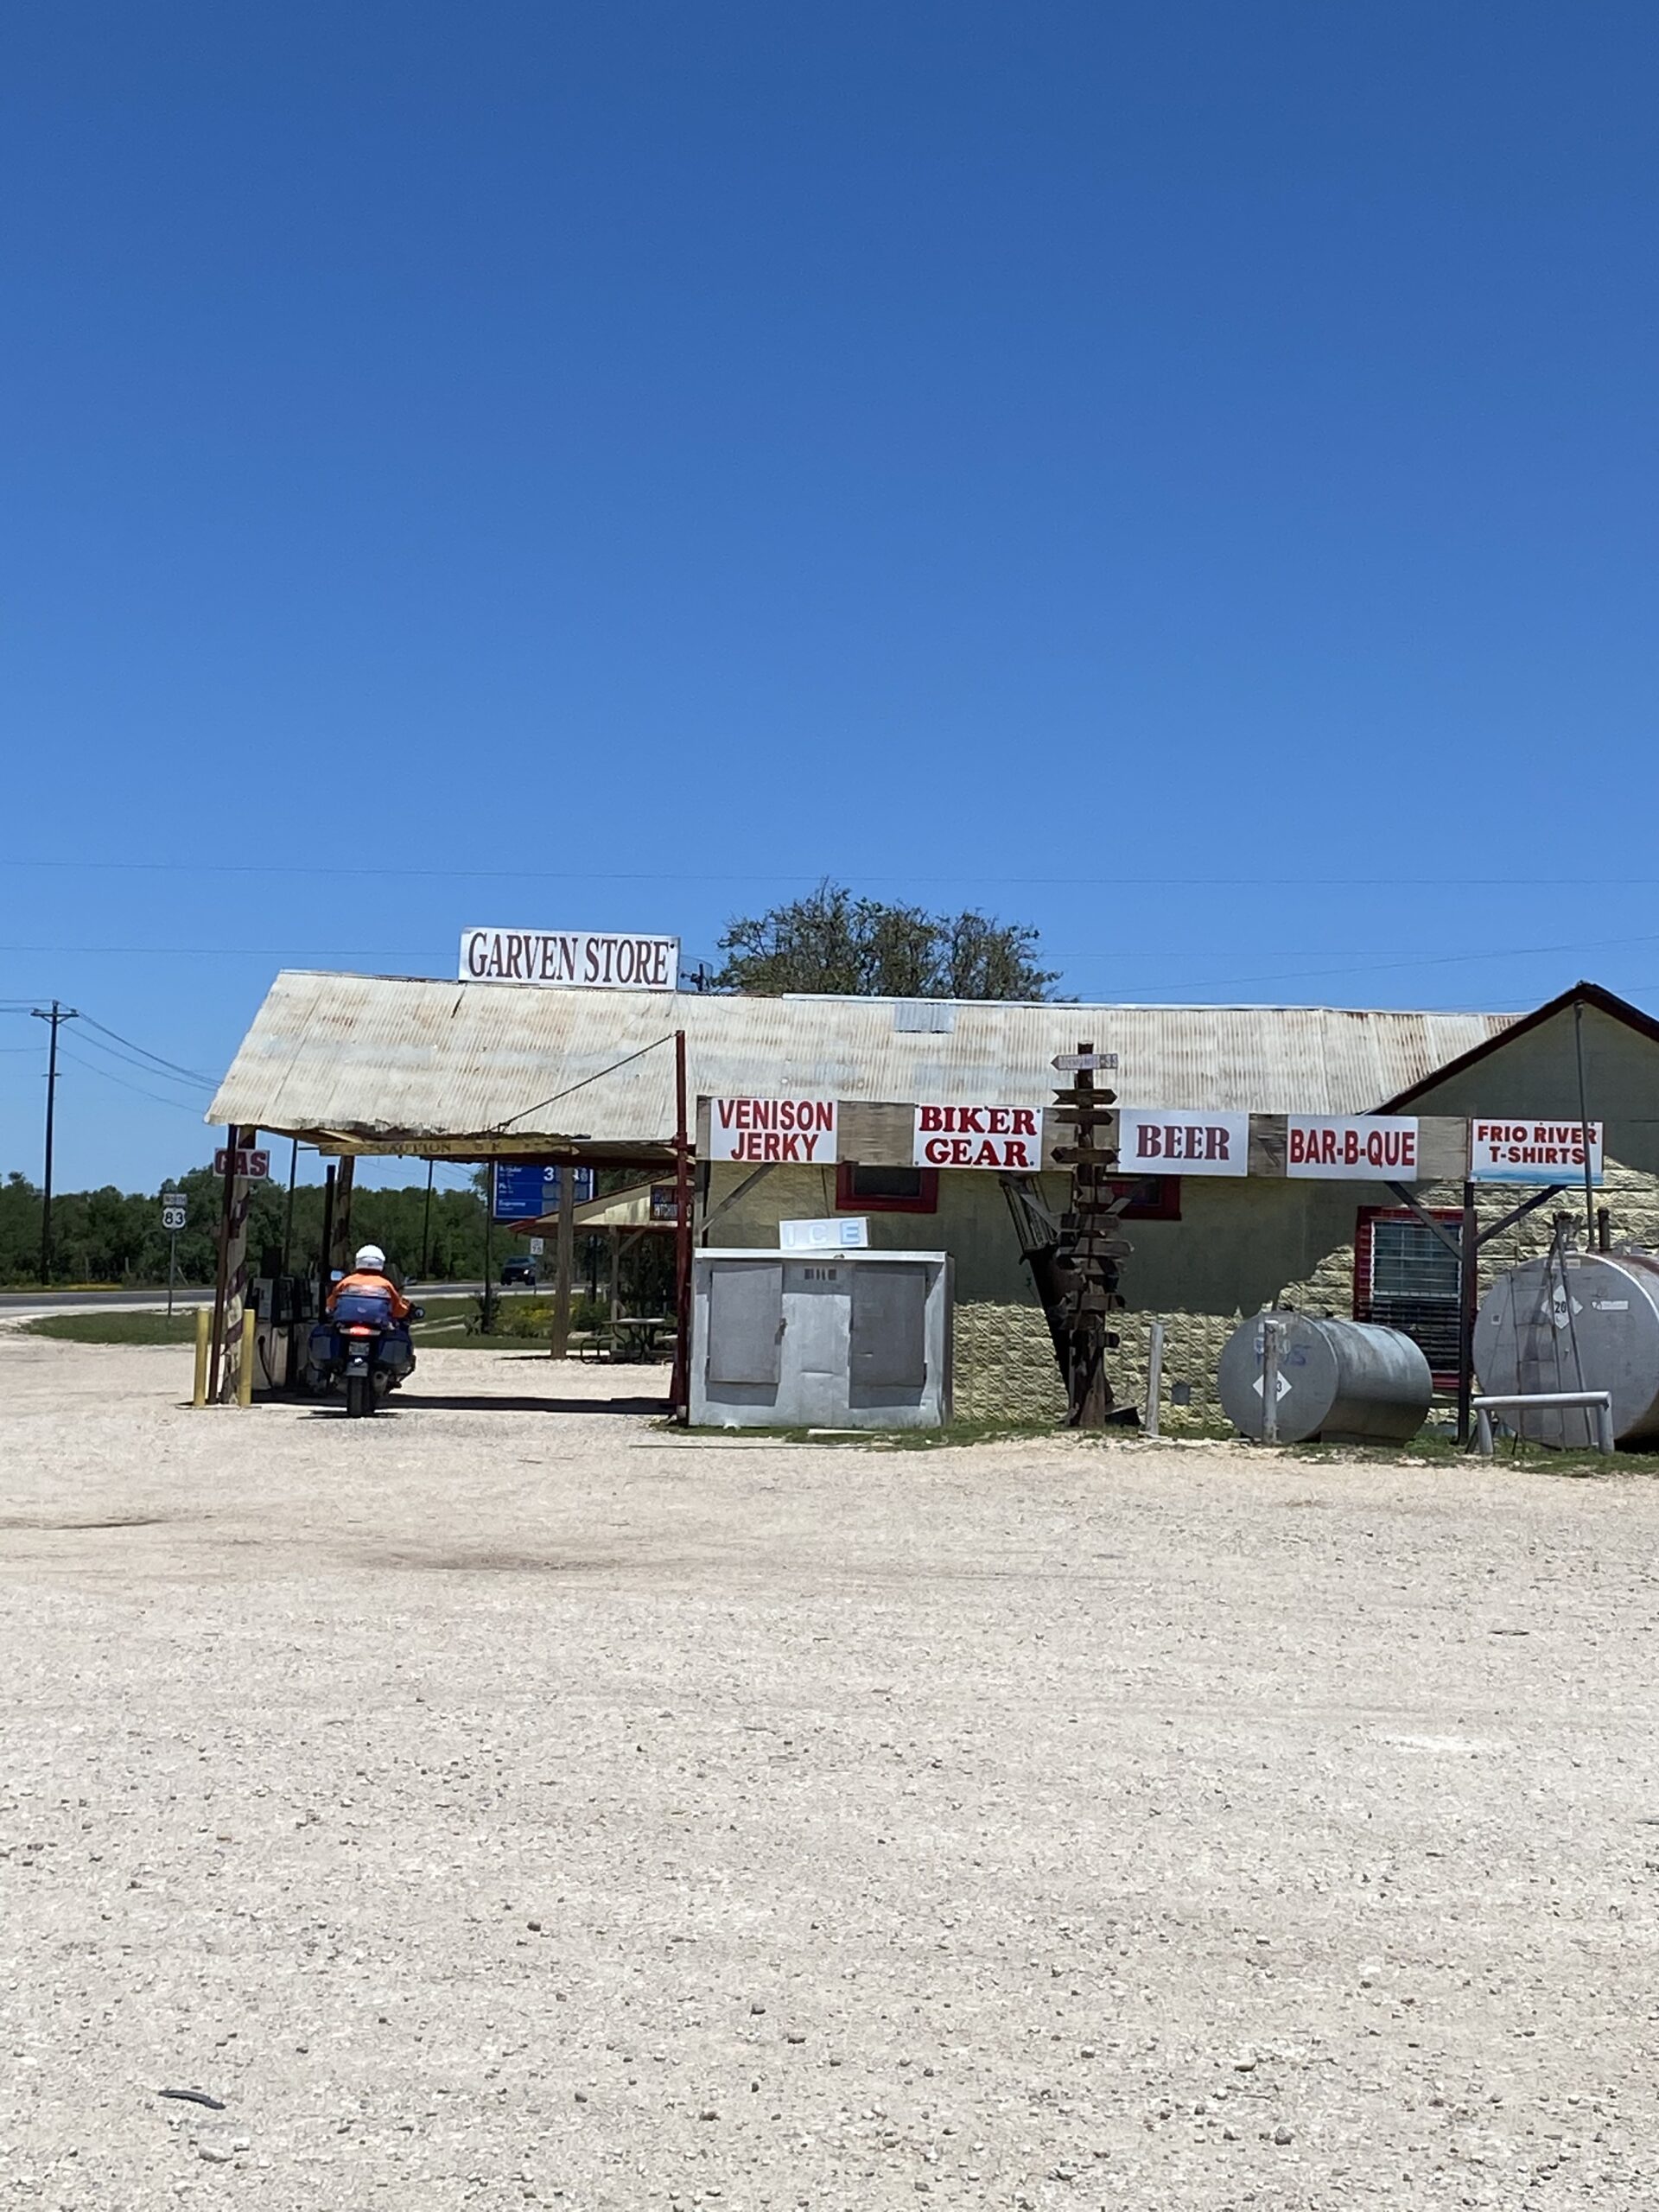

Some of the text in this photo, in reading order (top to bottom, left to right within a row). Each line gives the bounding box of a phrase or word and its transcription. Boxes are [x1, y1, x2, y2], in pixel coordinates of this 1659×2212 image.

[468, 932, 670, 986] GARVEN STORE
[718, 1100, 833, 1132] VENISON
[918, 1106, 1038, 1136] BIKER
[730, 1132, 819, 1161] JERKY
[1135, 1125, 1230, 1160] BEER
[1290, 1128, 1415, 1168] BAR-B-QUE
[1478, 1125, 1597, 1145] FRIO RIVER
[925, 1138, 1029, 1167] GEAR
[1489, 1146, 1586, 1165] T-SHIRTS
[165, 1211, 183, 1225] 83
[785, 1221, 861, 1247] ICE
